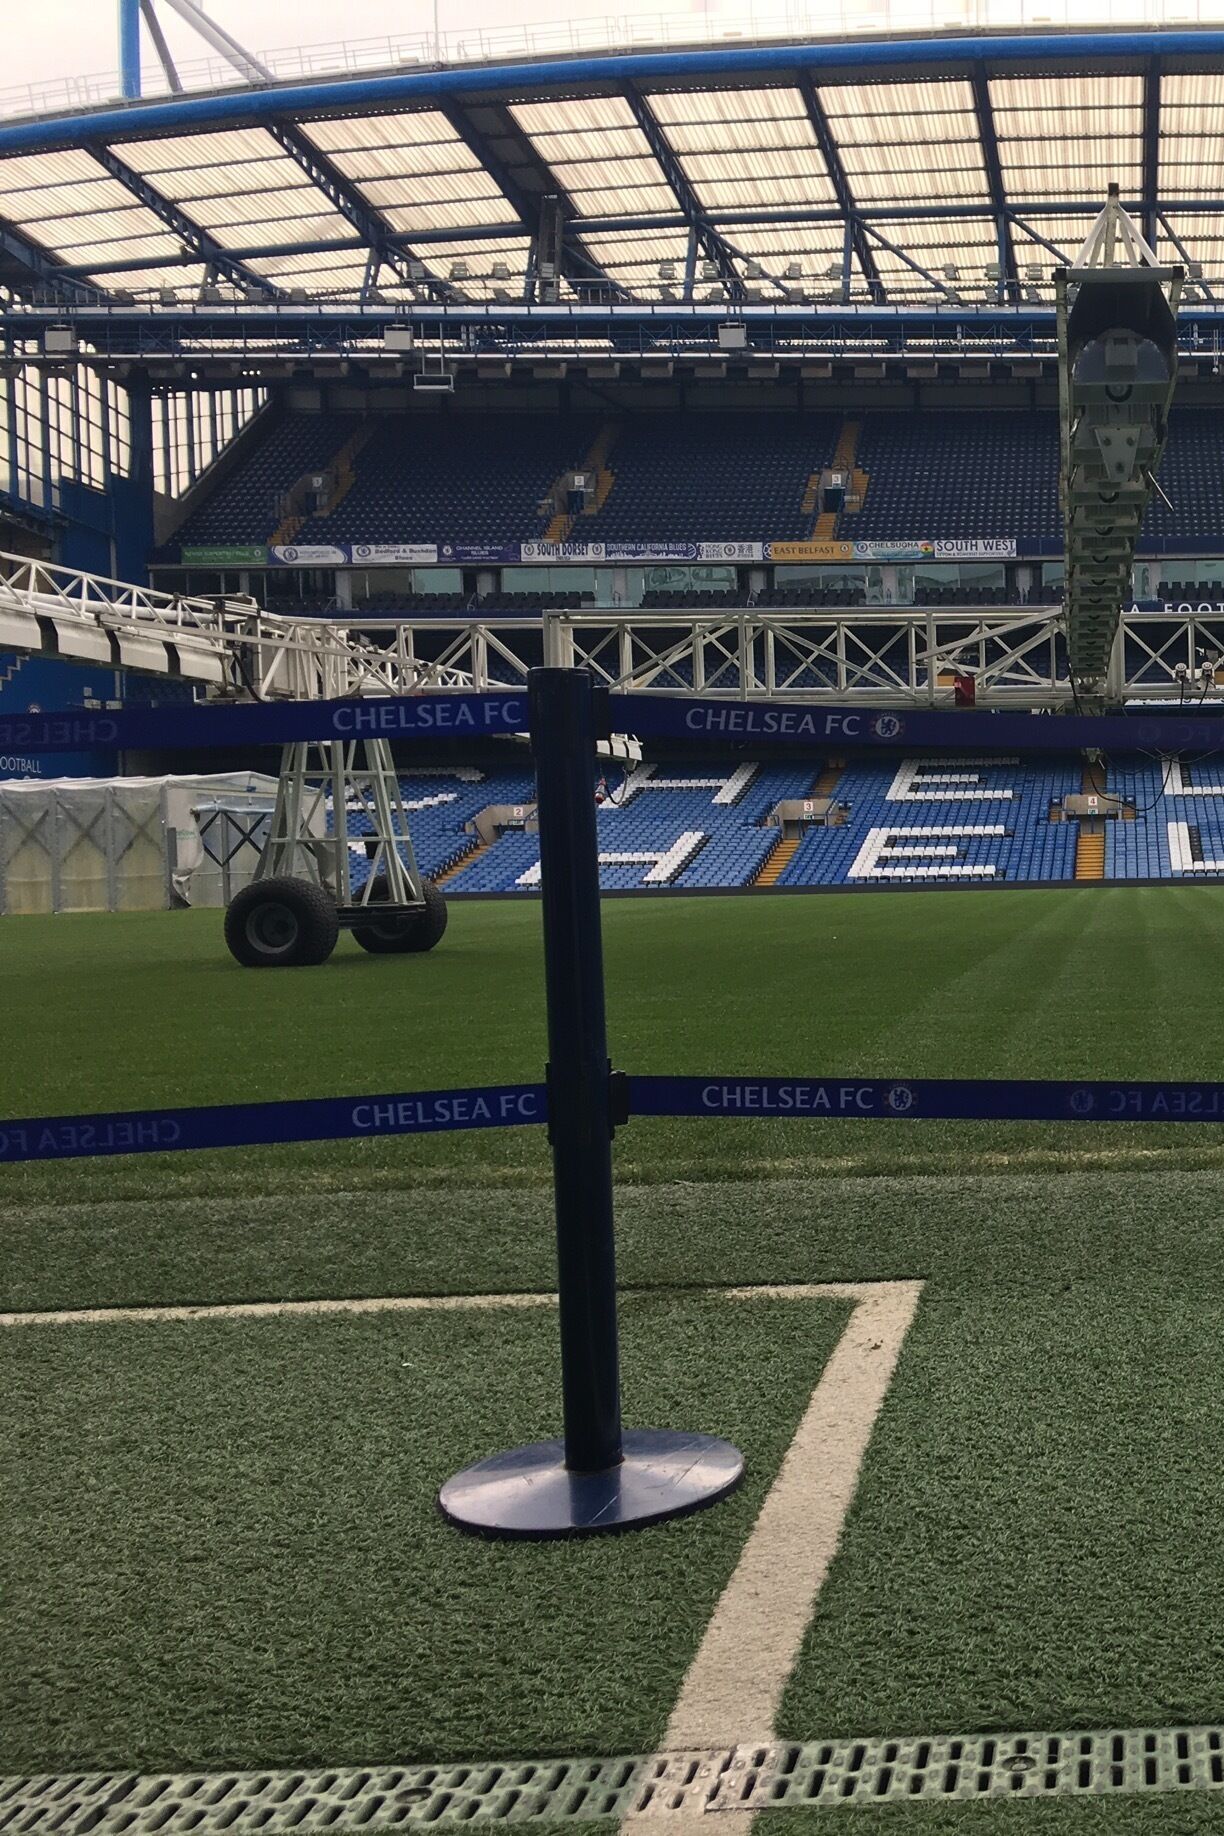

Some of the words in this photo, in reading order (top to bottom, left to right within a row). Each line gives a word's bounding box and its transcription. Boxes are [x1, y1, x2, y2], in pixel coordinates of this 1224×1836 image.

[536, 544, 560, 556] SOUTH
[562, 544, 589, 556] DORSET
[936, 540, 978, 552] SOUTH
[982, 540, 1015, 551] WEST
[332, 703, 475, 732] CHELSEA
[484, 700, 522, 724] FC
[685, 708, 816, 734] CHELSEA
[825, 714, 860, 736] FC
[352, 1096, 492, 1128] CHELSEA
[500, 1092, 537, 1118] FC
[702, 1085, 832, 1110] CHELSEA
[840, 1087, 874, 1110] FC
